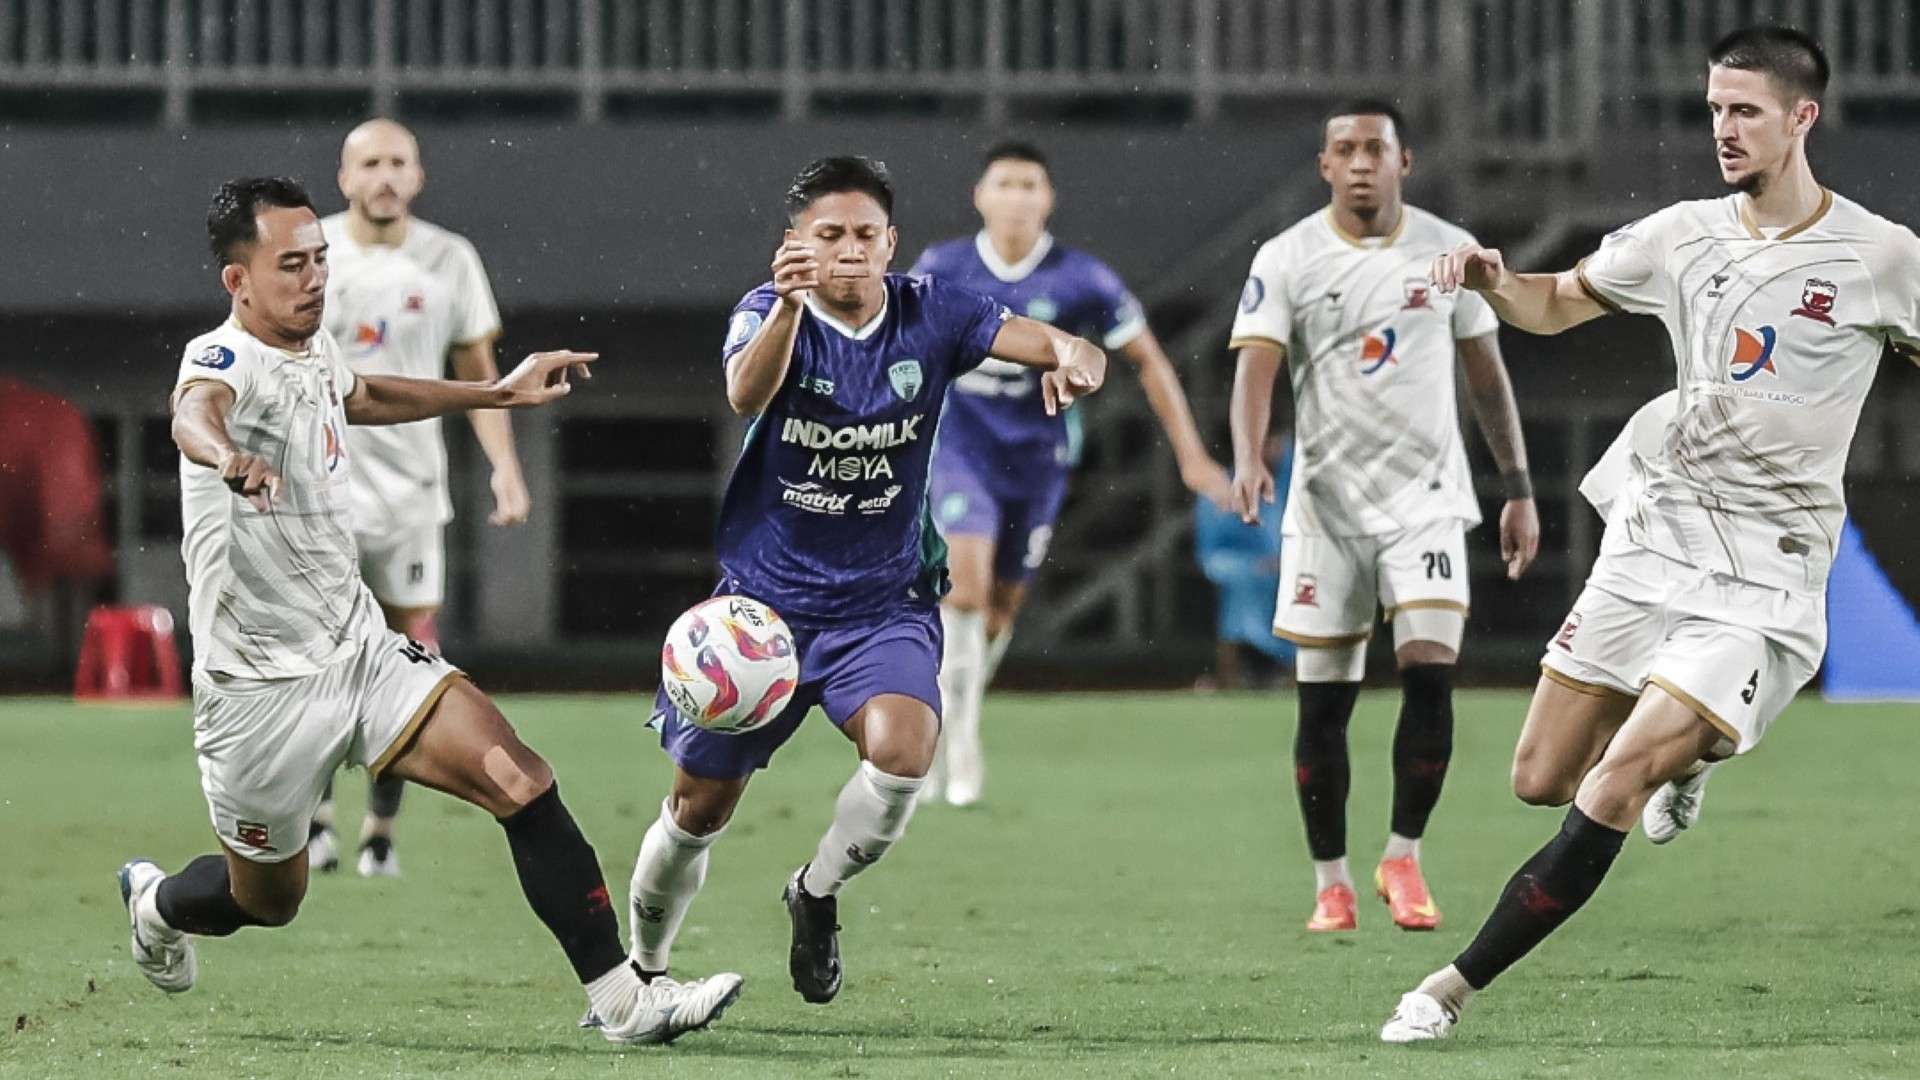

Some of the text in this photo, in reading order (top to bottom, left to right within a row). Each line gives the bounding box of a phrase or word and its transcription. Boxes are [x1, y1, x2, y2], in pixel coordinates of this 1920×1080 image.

[799, 374, 835, 396] 153
[781, 414, 924, 450] INDOMILK
[808, 453, 893, 481] MOYA
[783, 488, 853, 511] matrix
[1421, 551, 1452, 580] 70
